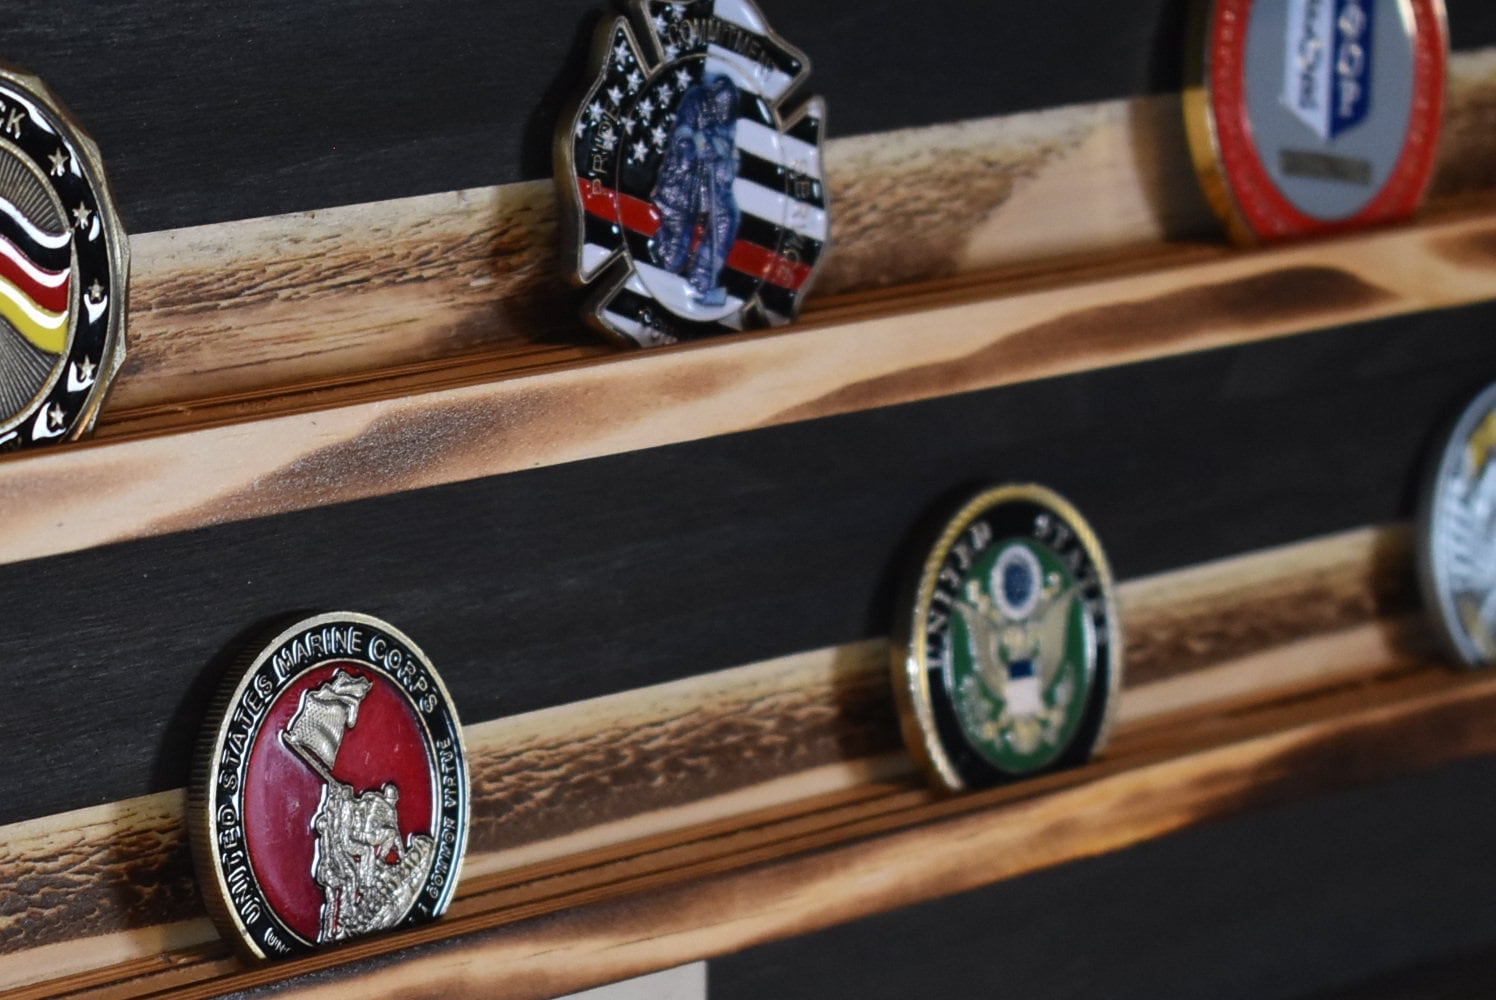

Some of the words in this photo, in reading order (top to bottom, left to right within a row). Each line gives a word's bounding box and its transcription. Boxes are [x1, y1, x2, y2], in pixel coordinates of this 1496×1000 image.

[273, 626, 364, 678] MARINE
[368, 634, 438, 714] CORPS
[219, 673, 273, 792] STATES
[436, 736, 458, 808] VIRTUE
[219, 804, 262, 926] UNITED
